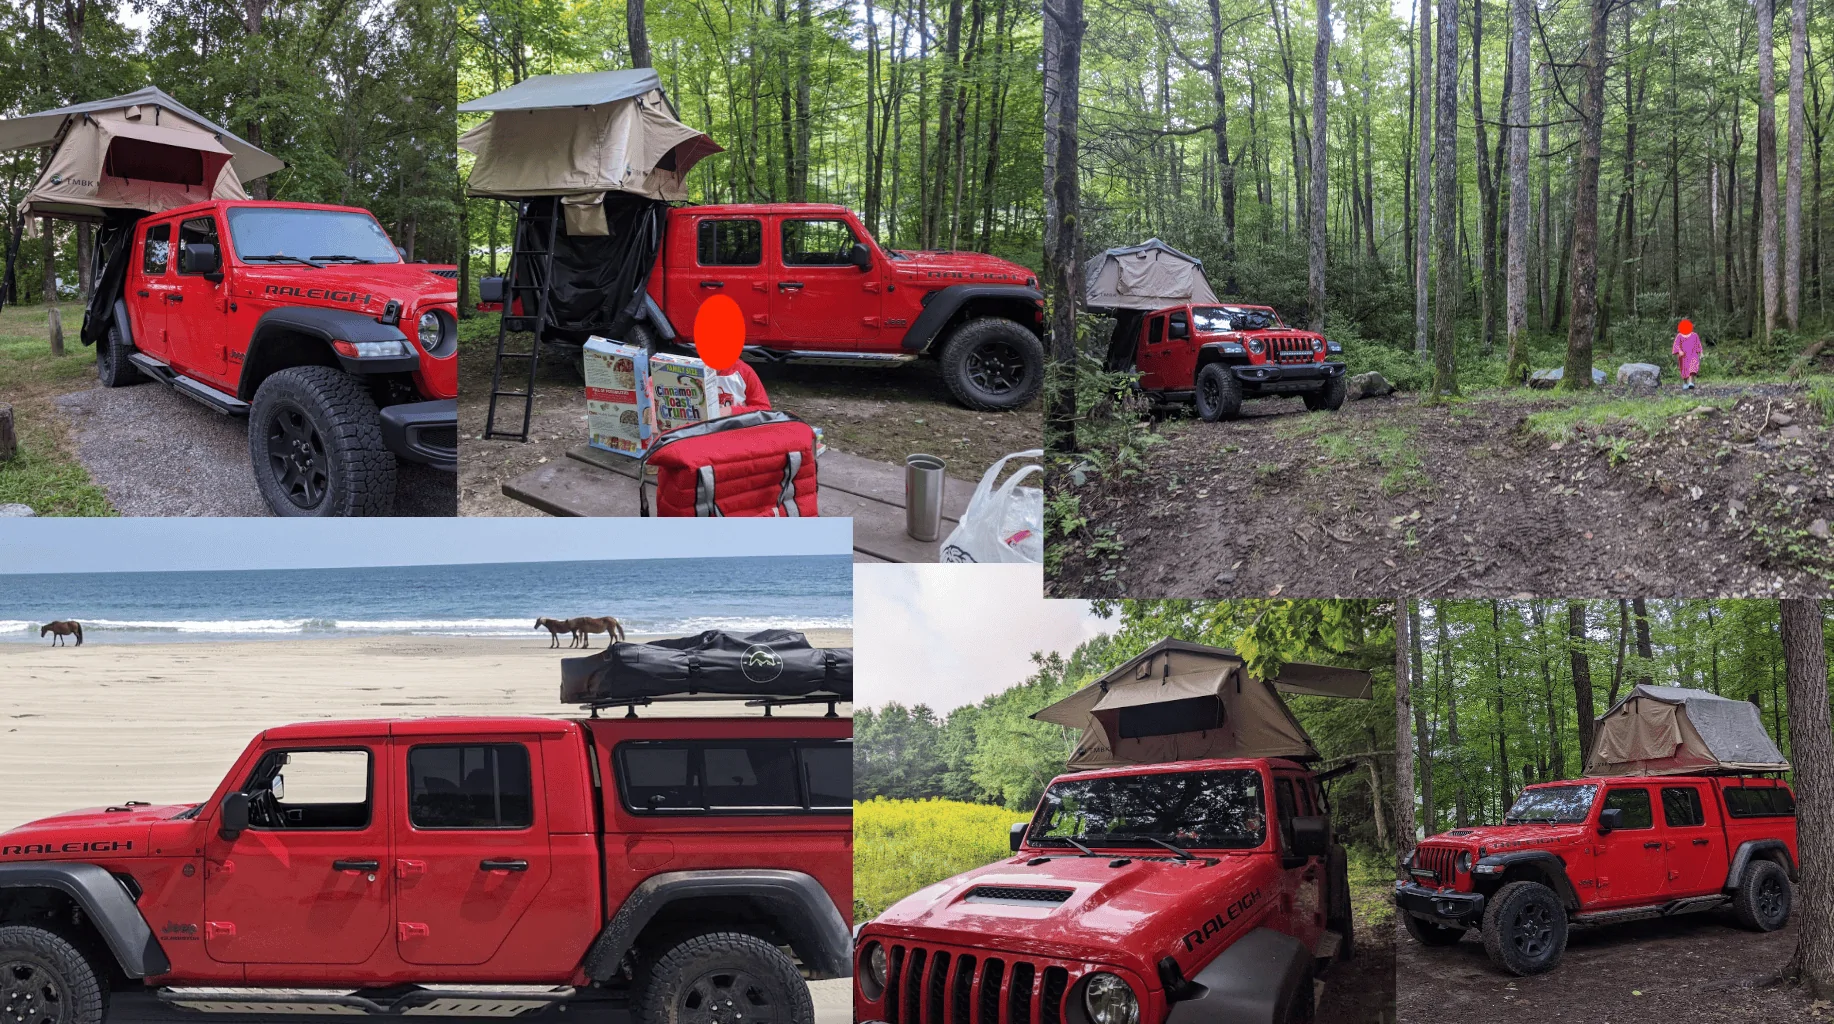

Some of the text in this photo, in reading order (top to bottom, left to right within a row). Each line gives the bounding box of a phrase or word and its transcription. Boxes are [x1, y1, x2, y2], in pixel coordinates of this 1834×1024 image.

[66, 177, 94, 187] TMBK
[265, 285, 371, 304] RALEIGH
[655, 384, 698, 398] Cinnamon
[664, 395, 692, 408] Toast
[660, 405, 701, 420] Crunch
[2, 840, 133, 855] RALEIGH
[161, 920, 198, 935] Jeep
[1182, 887, 1262, 953] RALEIGH
